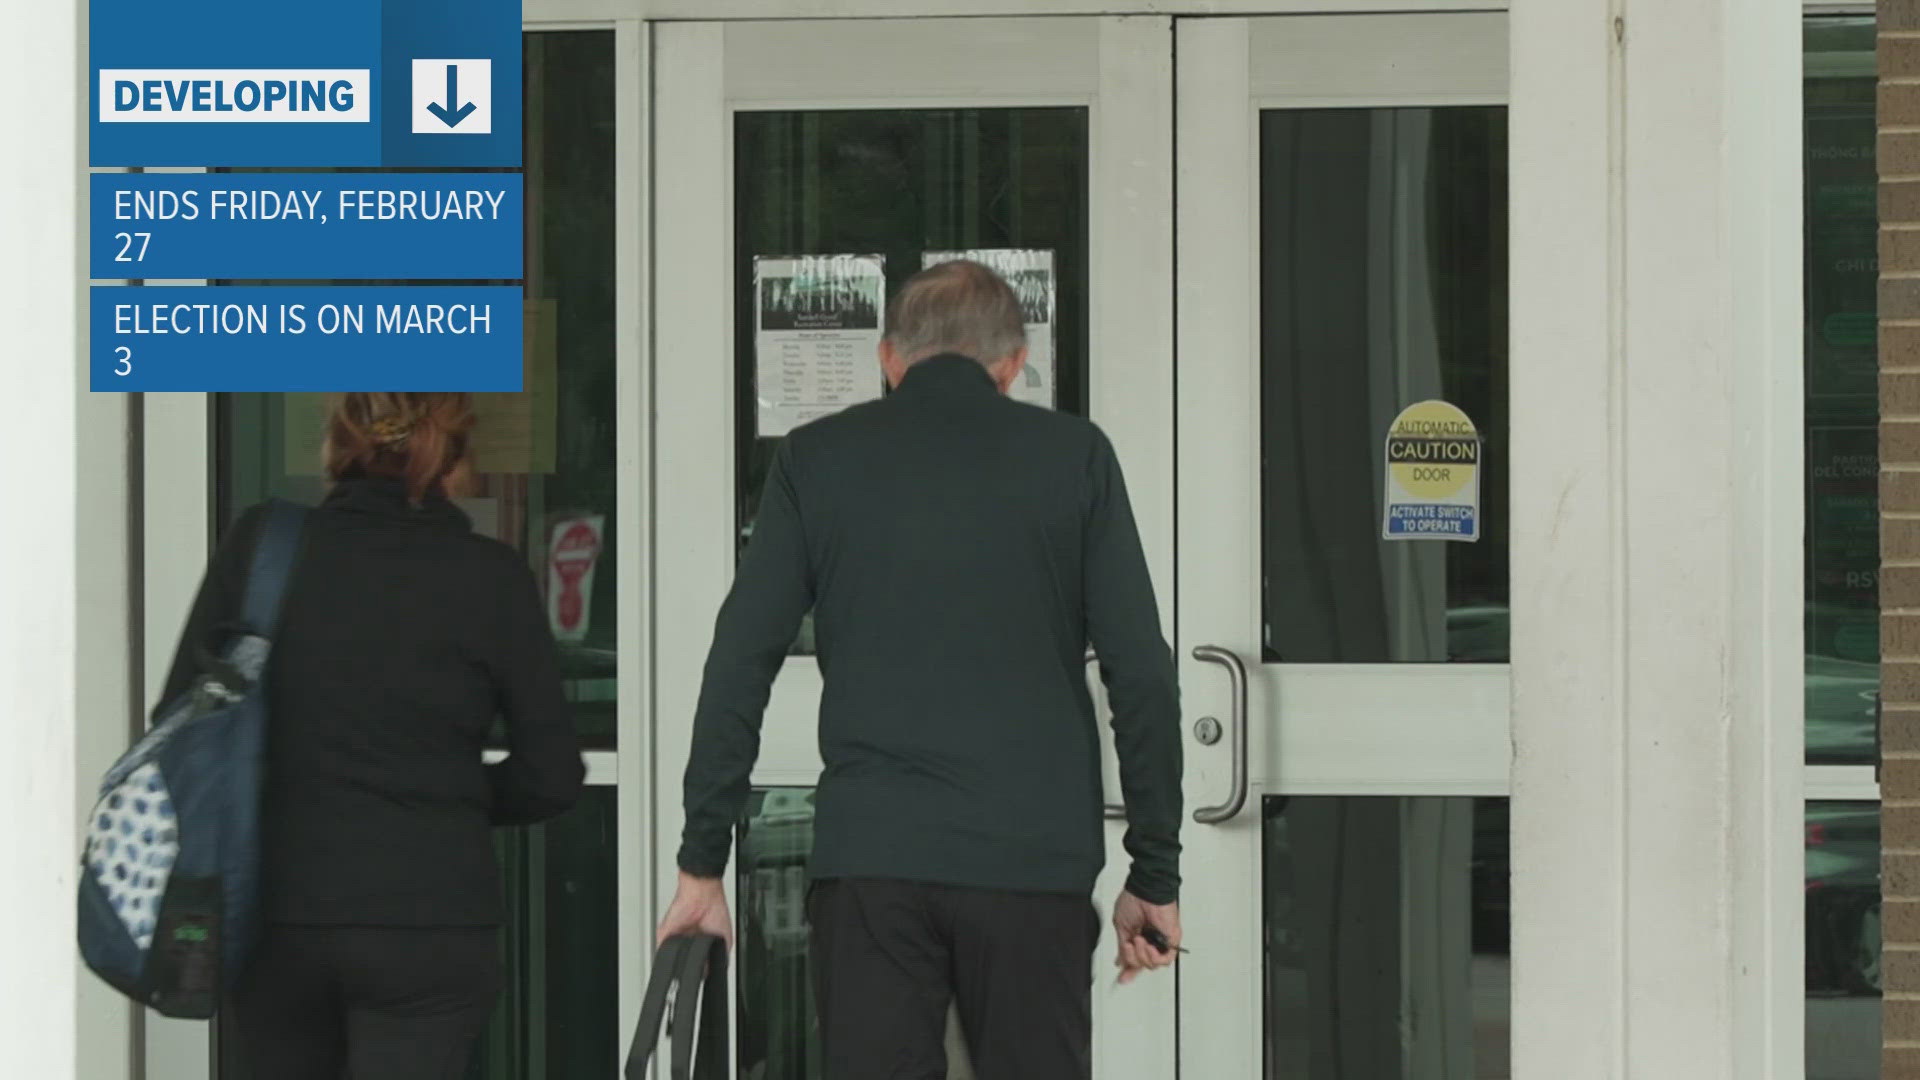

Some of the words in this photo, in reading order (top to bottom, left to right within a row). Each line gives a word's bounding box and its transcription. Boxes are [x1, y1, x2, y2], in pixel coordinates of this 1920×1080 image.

[1396, 421, 1469, 434] AUTOMATIC
[1391, 442, 1475, 460] CAUTION
[1413, 467, 1451, 481] DOOR
[1390, 506, 1436, 519] ACTIVATE
[1437, 507, 1474, 519] SWITCH
[1402, 520, 1416, 532] TO
[1418, 521, 1461, 532] OPERATE
